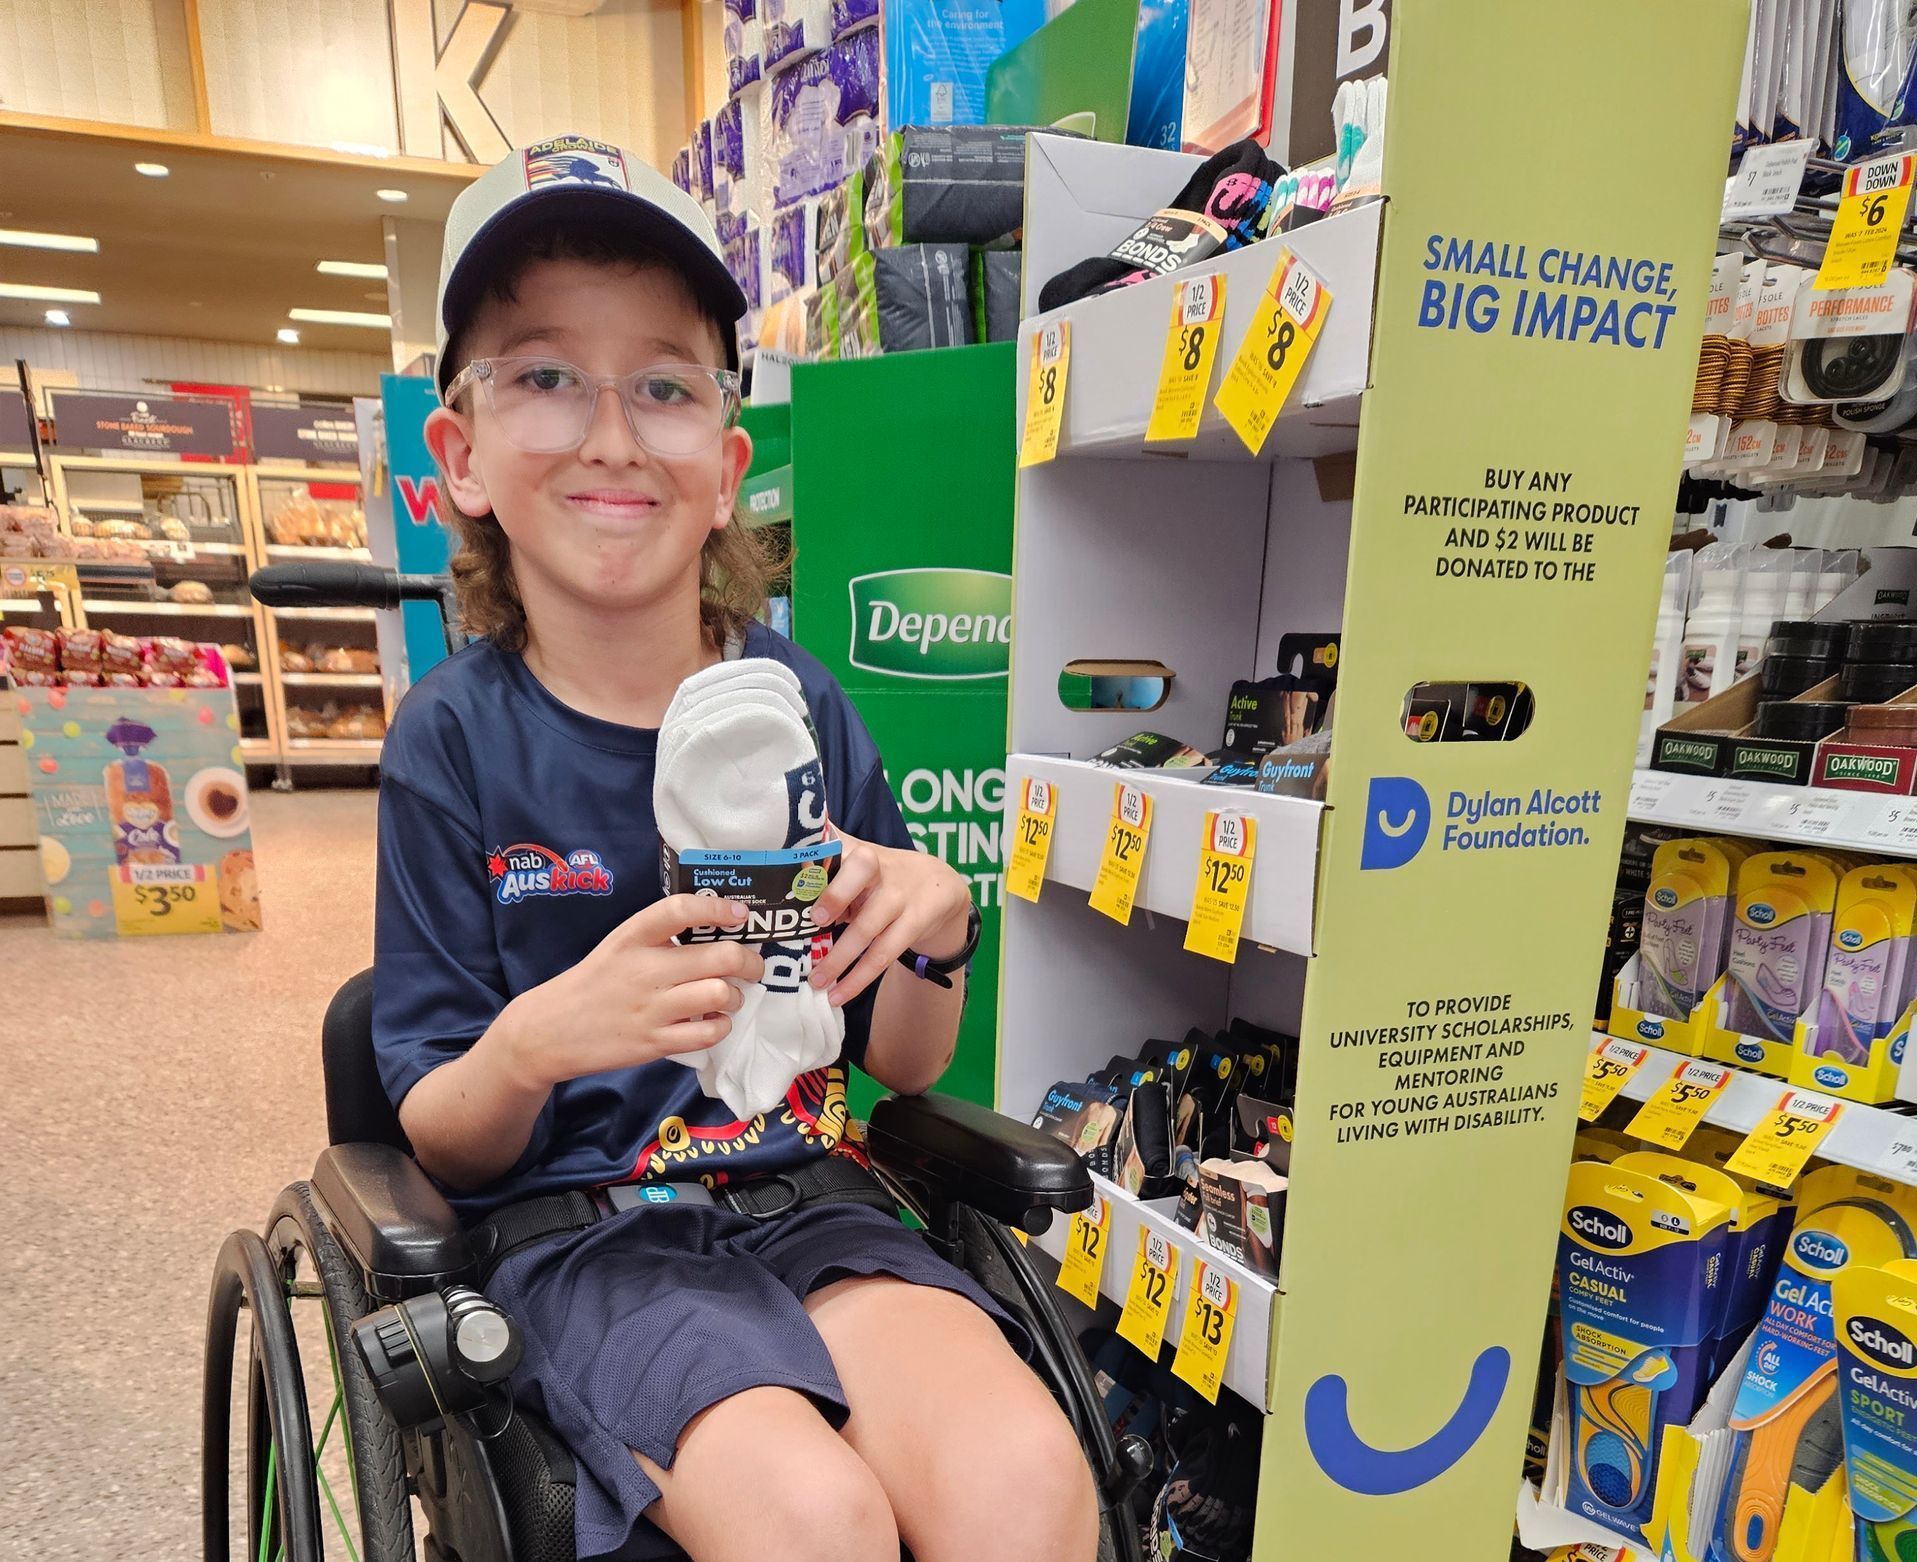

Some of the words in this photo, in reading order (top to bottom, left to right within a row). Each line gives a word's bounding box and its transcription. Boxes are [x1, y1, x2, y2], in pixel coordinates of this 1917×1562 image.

[942, 9, 973, 20] Caring
[975, 9, 989, 18] for
[944, 21, 1004, 30] environment
[1160, 121, 1177, 147] 32
[529, 137, 619, 156] ADELAIDE
[1867, 161, 1899, 179] DOWN
[1865, 174, 1896, 191] DOWN
[1859, 195, 1889, 227] $6
[1844, 232, 1858, 240] WAS
[1874, 228, 1888, 236] 2024
[1116, 239, 1182, 272] BONDS
[1423, 234, 1528, 280] SMALL
[1538, 248, 1677, 302] CHANGE,
[1192, 284, 1205, 302] 1/2
[1294, 272, 1309, 297] 1/2
[1187, 302, 1207, 318] PRICE
[1284, 287, 1307, 317] PRICE
[1809, 295, 1895, 318] PERFORMANCE
[1417, 279, 1501, 334] BIG
[1511, 289, 1676, 350] IMPACT
[1756, 305, 1790, 326] BOTTES
[1179, 325, 1205, 371] $8
[1267, 306, 1295, 371] $8
[1039, 366, 1057, 405] $8
[1842, 406, 1863, 417] POLISH
[1863, 403, 1886, 413] SPONGE
[1737, 435, 1761, 452] 152CM
[1484, 468, 1525, 491] BUY
[1527, 470, 1573, 493] ANY
[1403, 494, 1547, 522] PARTICIPATING
[1551, 503, 1640, 526] PRODUCT
[1444, 527, 1490, 550] AND
[1494, 526, 1519, 553] $2
[1524, 530, 1567, 552] WILL
[1572, 532, 1595, 553] BE
[1435, 556, 1529, 580] DONATED
[1533, 559, 1559, 581] TO
[1563, 561, 1596, 582] THE
[1230, 694, 1258, 711] Active
[1664, 741, 1714, 761] OAKWOOD
[1738, 750, 1794, 769] OAKWOOD
[1262, 758, 1315, 783] Guyfront
[1831, 758, 1893, 776] OAKWOOD
[898, 768, 1008, 814] ONG
[1031, 796, 1045, 809] PRICE
[1034, 785, 1044, 797] 1/2
[1127, 792, 1137, 808] 1/2
[1123, 806, 1139, 822] PRICE
[1447, 791, 1521, 825] Dylan
[1526, 788, 1602, 817] Alcott
[1223, 820, 1236, 835] 1/2
[1443, 820, 1590, 851] Foundation.
[908, 821, 1008, 864] STIN
[1218, 836, 1238, 850] PRICE
[508, 852, 543, 871] nab
[569, 854, 599, 866] AFL
[799, 850, 820, 859] PACK
[134, 867, 153, 880] 1/2
[155, 867, 192, 881] PRICE
[501, 867, 610, 899] Auskick
[693, 868, 736, 876] Cushioned
[693, 876, 726, 887] Low
[728, 875, 753, 887] Cut
[1656, 891, 1676, 905] Scholl
[1645, 912, 1671, 937] Party
[1671, 920, 1695, 936] Feet
[1748, 906, 1775, 920] Scholl
[1735, 928, 1770, 955] Party
[1769, 935, 1797, 953] Feet
[1840, 933, 1862, 945] Scholl
[1833, 951, 1862, 974] Party
[1860, 959, 1881, 973] Feet
[1407, 1001, 1430, 1018] TO
[1435, 994, 1512, 1016] PROVIDE
[1330, 1024, 1437, 1049] UNIVERSITY
[1441, 1012, 1575, 1040] SCHOLARSHIPS,
[1638, 1020, 1662, 1037] Scholl
[1378, 1044, 1483, 1069] EQUIPMENT
[1486, 1040, 1525, 1059] AND
[1608, 1045, 1619, 1055] 1/2
[1619, 1048, 1639, 1060] PRICE
[1737, 1045, 1763, 1060] Scholl
[1394, 1065, 1503, 1091] MENTORING
[1687, 1067, 1700, 1077] 1/2
[1701, 1070, 1721, 1083] PRICE
[1816, 1069, 1847, 1085] Scholl
[1047, 1089, 1083, 1113] Guyfront
[1329, 1102, 1365, 1121] FOR
[1371, 1094, 1438, 1116] YOUNG
[1443, 1082, 1558, 1109] AUSTRALIANS
[1792, 1098, 1805, 1109] 1/2
[1805, 1102, 1830, 1115] PRICE
[1337, 1121, 1399, 1144] LIVING
[1404, 1116, 1449, 1136] WITH
[1454, 1106, 1545, 1132] DISABILITY.
[1200, 1178, 1236, 1202] Seamless
[1076, 1214, 1100, 1259] $12
[1572, 1210, 1627, 1244] Scholl
[1152, 1237, 1163, 1251] 1/2
[1209, 1233, 1244, 1260] BONDS
[1798, 1236, 1845, 1266] Scholl
[1149, 1249, 1164, 1265] PRICE
[1570, 1251, 1632, 1283] GelActiv
[1140, 1259, 1166, 1309] $12
[1209, 1272, 1221, 1287] 1/2
[1569, 1271, 1627, 1303] CASUAL
[1205, 1284, 1223, 1302] PRICE
[1568, 1285, 1594, 1301] COMFY
[1594, 1295, 1613, 1307] FEET
[1195, 1295, 1224, 1346] $13
[1568, 1296, 1602, 1313] Customised
[1602, 1308, 1629, 1323] comfort
[1629, 1317, 1640, 1326] for
[1640, 1322, 1665, 1333] people
[1576, 1306, 1587, 1314] the
[1587, 1311, 1605, 1321] move
[1769, 1300, 1818, 1331] WORK
[1575, 1325, 1602, 1340] SHOCK
[1575, 1331, 1627, 1356] ABSORPTION
[1762, 1324, 1813, 1351] HARD-WORKING
[1813, 1345, 1831, 1357] FEET
[1764, 1317, 1776, 1327] ALL
[1776, 1321, 1789, 1331] DAY
[1789, 1326, 1822, 1345] COMFORT
[1821, 1337, 1837, 1350] FOR
[1850, 1320, 1913, 1365] Scholl
[1763, 1352, 1780, 1367] ALL
[1763, 1361, 1777, 1371] DAY
[1746, 1370, 1779, 1392] SHOCK
[1851, 1389, 1905, 1427] SPORT
[1595, 1509, 1637, 1533] GELWAVE
[1584, 1543, 1608, 1562] PRICE
